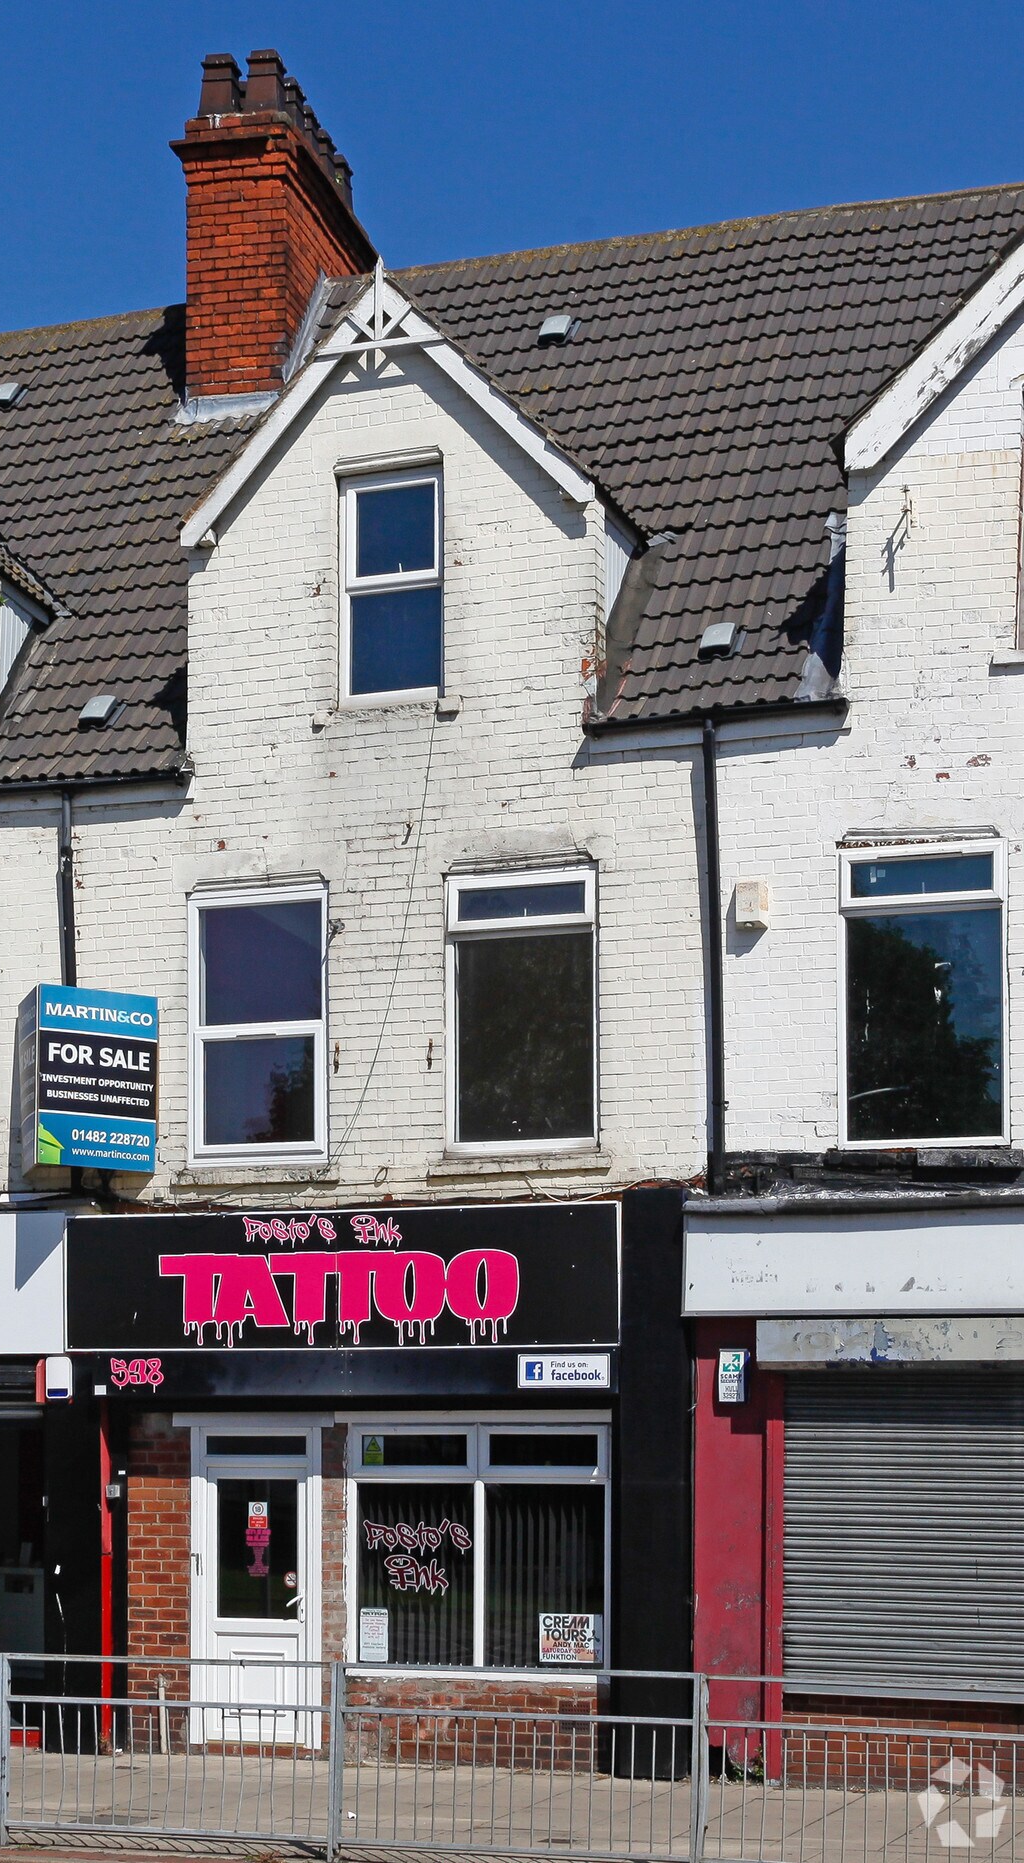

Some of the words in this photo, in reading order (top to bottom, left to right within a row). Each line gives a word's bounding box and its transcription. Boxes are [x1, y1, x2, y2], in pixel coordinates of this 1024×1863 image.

[45, 1002, 153, 1026] MARTIN&CO
[48, 1042, 94, 1065] FOR
[99, 1048, 150, 1071] SALE
[42, 1074, 97, 1086] INVESTMENT
[98, 1079, 153, 1092] OPPORTUNITY
[47, 1090, 99, 1101] BUSINESSES
[101, 1095, 149, 1106] UNAFFECTED
[72, 1129, 107, 1143] 01482
[110, 1133, 149, 1147] 228720
[72, 1147, 149, 1161] www.martinco.com
[159, 1249, 519, 1346] TATTOO
[110, 1358, 164, 1389] 538
[551, 1369, 601, 1381] facebook
[542, 1615, 589, 1629] CREAM
[543, 1629, 587, 1641] TOURS
